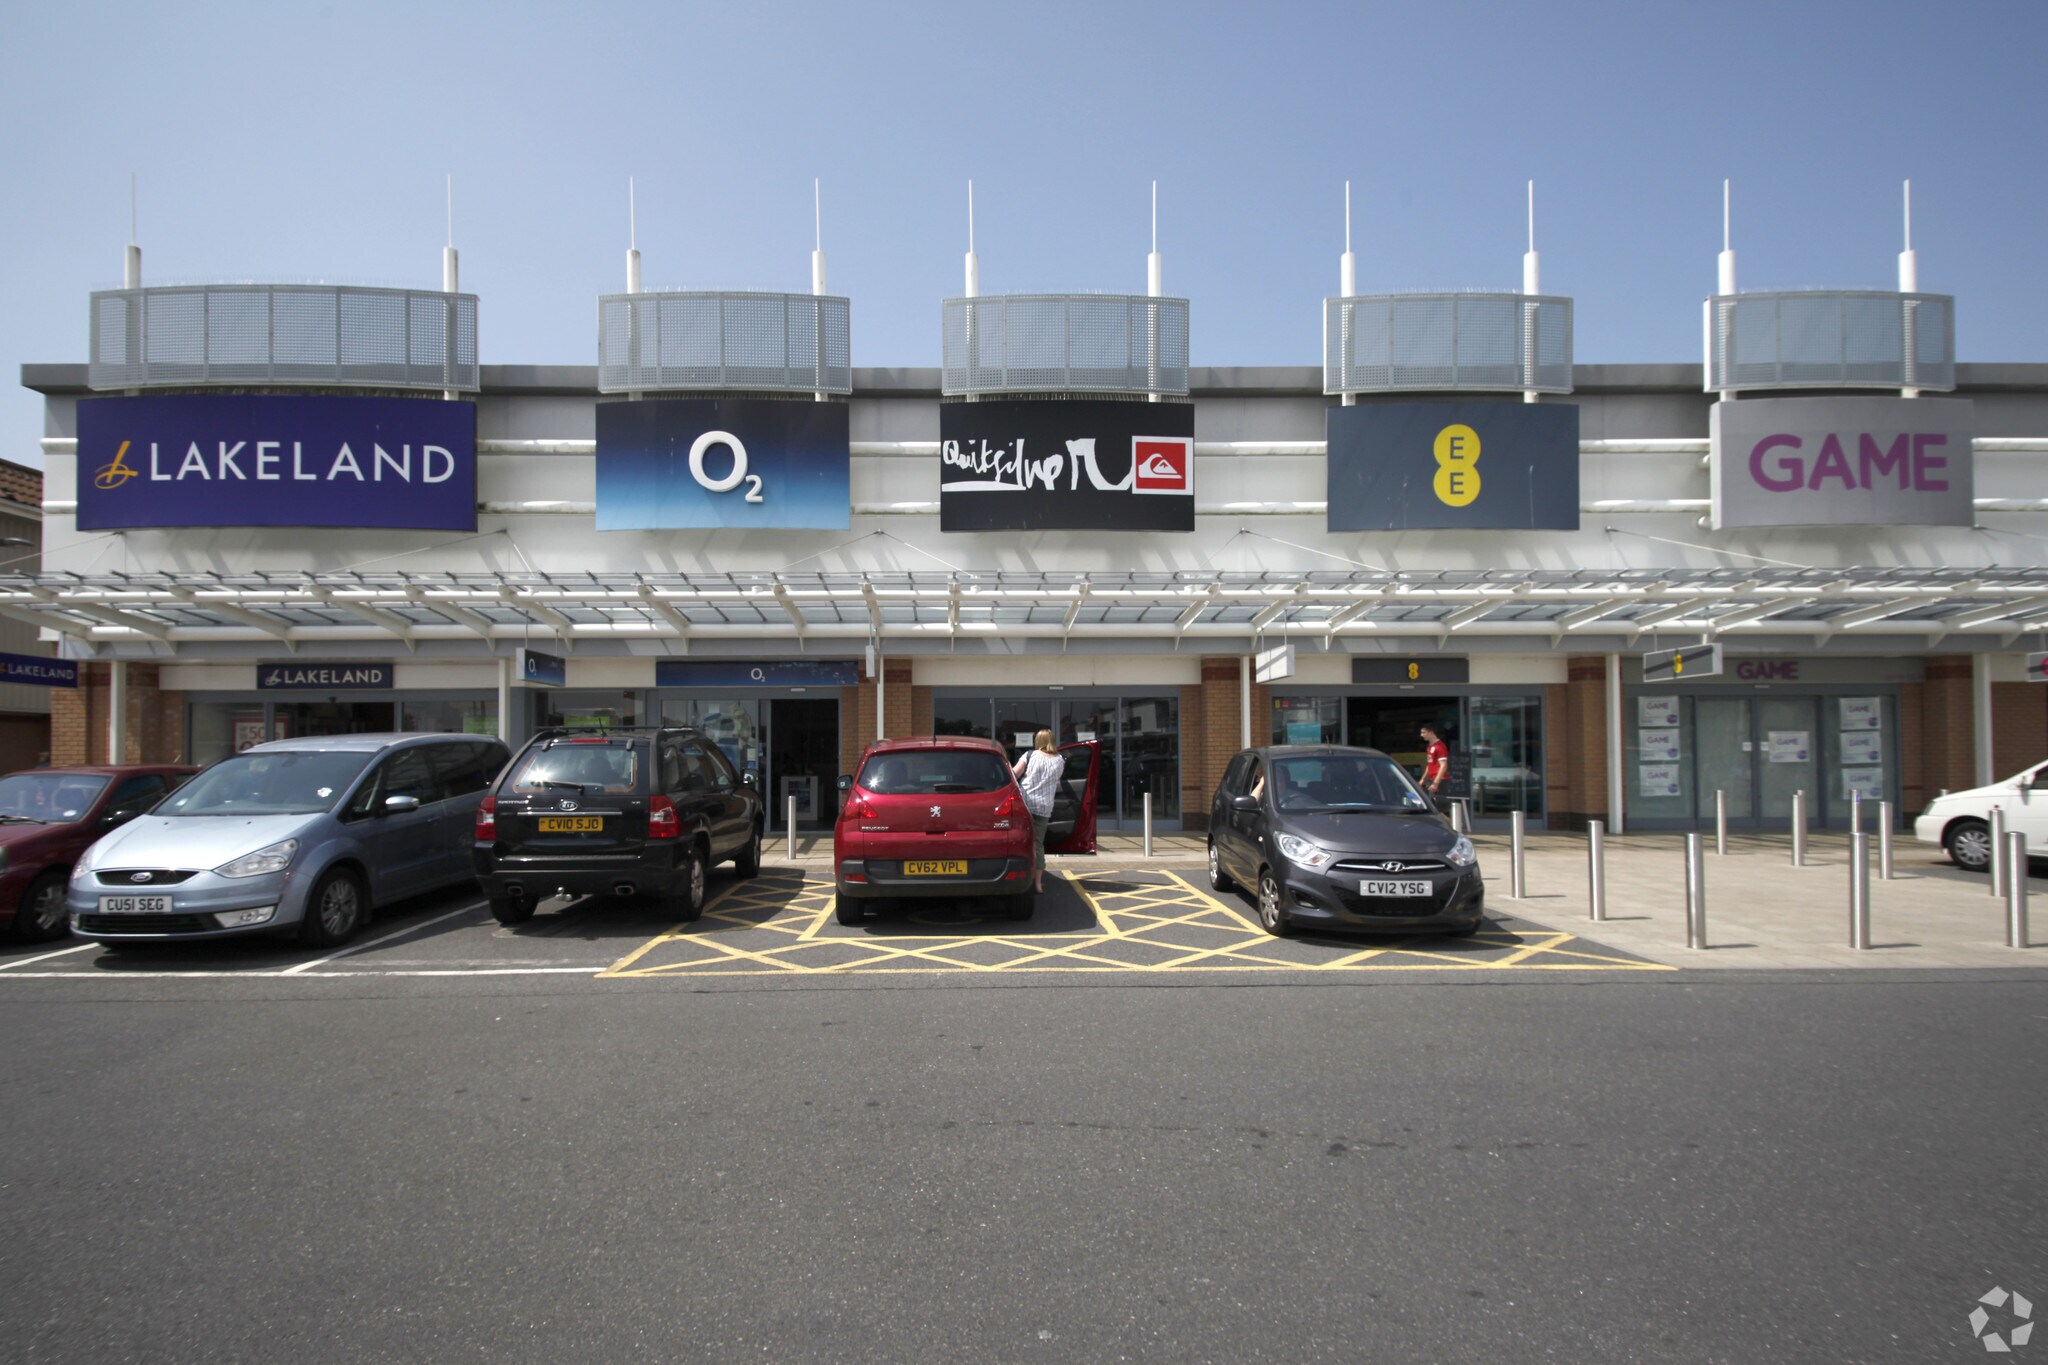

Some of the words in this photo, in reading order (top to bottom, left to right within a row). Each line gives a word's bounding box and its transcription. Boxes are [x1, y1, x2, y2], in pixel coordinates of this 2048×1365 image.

[150, 441, 455, 484] LAKELAND
[1748, 433, 1950, 492] GAME
[8, 663, 74, 679] LAKELAND
[284, 669, 382, 684] LAKELAND
[1736, 661, 1799, 680] GAME
[548, 818, 573, 830] CV10
[908, 862, 938, 873] CV62
[941, 861, 963, 873] VPL
[1367, 882, 1397, 894] CV12
[1400, 882, 1425, 894] YSG
[138, 898, 164, 911] SEG
